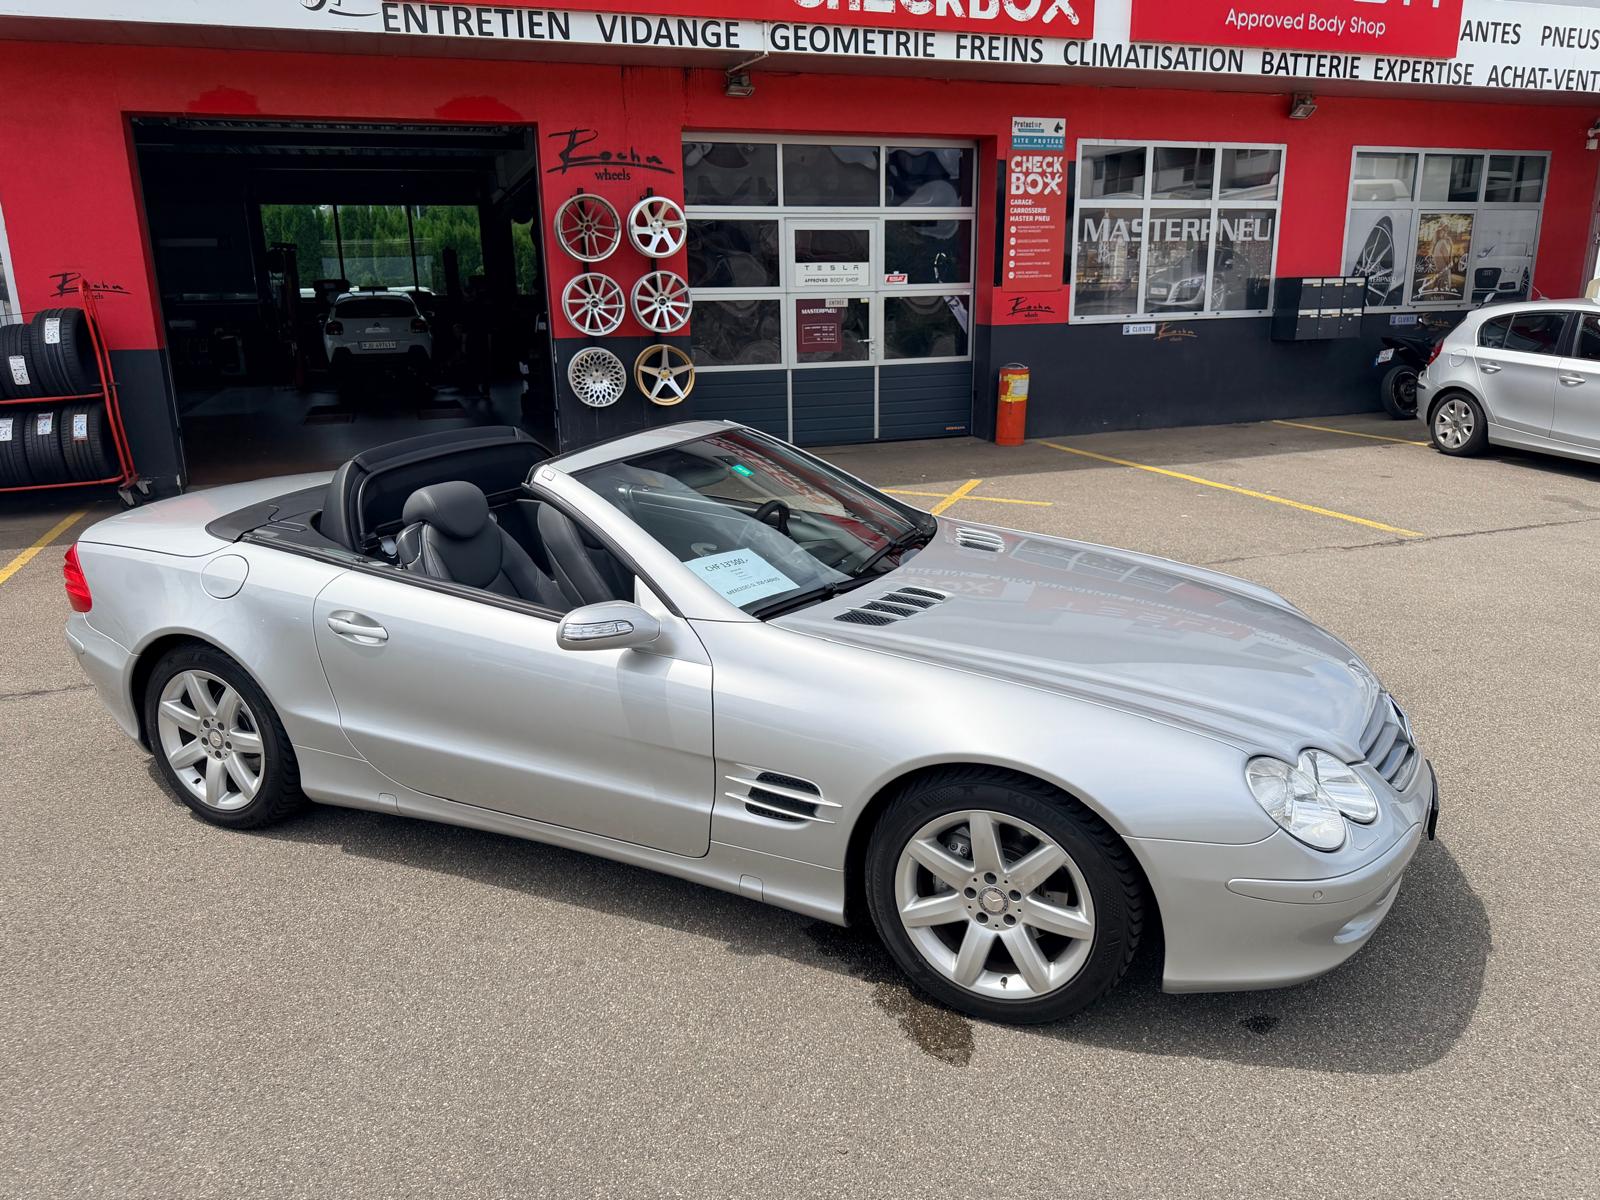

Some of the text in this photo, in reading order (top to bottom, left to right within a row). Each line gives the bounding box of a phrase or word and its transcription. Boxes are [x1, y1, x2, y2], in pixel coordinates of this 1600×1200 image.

[1225, 8, 1386, 38] Approved Body Shop
[1460, 20, 1600, 50] ANTES PNEUS
[382, 2, 1600, 92] ENTRETIEN VIDANGE GEOMETRIE FREINS CLIMATISATION BATTERIE EXPERTISE ACHAT-VENT
[595, 168, 631, 181] wheels
[1010, 156, 1064, 173] CHECK
[1010, 172, 1063, 196] BOX
[1083, 218, 1272, 242] MASTERPNEU
[49, 272, 133, 298] Rcha
[704, 563, 720, 572] CHF
